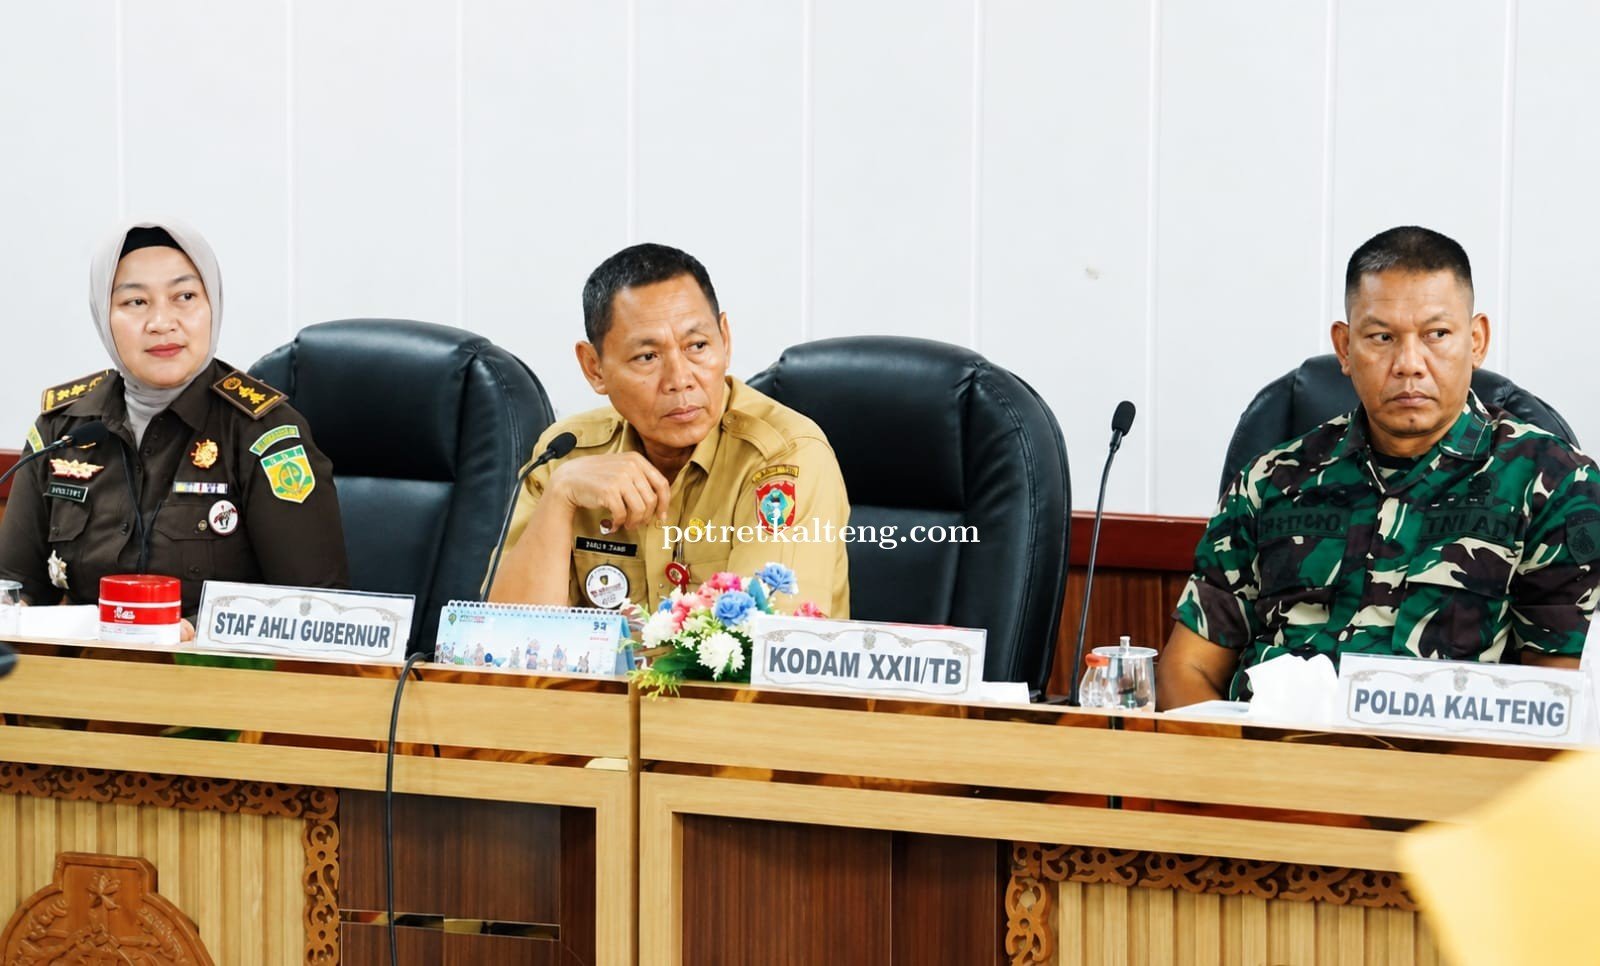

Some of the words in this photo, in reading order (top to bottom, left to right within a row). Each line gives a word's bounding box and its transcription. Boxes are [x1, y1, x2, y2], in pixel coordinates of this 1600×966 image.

[1426, 514, 1467, 534] TNI
[1472, 515, 1511, 538] AD
[215, 611, 256, 636] STAF
[258, 616, 297, 641] AHLI
[300, 619, 391, 648] GUBERNUR
[769, 646, 861, 678] KODAM
[867, 653, 962, 685] XXII/TB
[1354, 688, 1436, 718] POLDA
[1444, 695, 1565, 728] KALTENG
